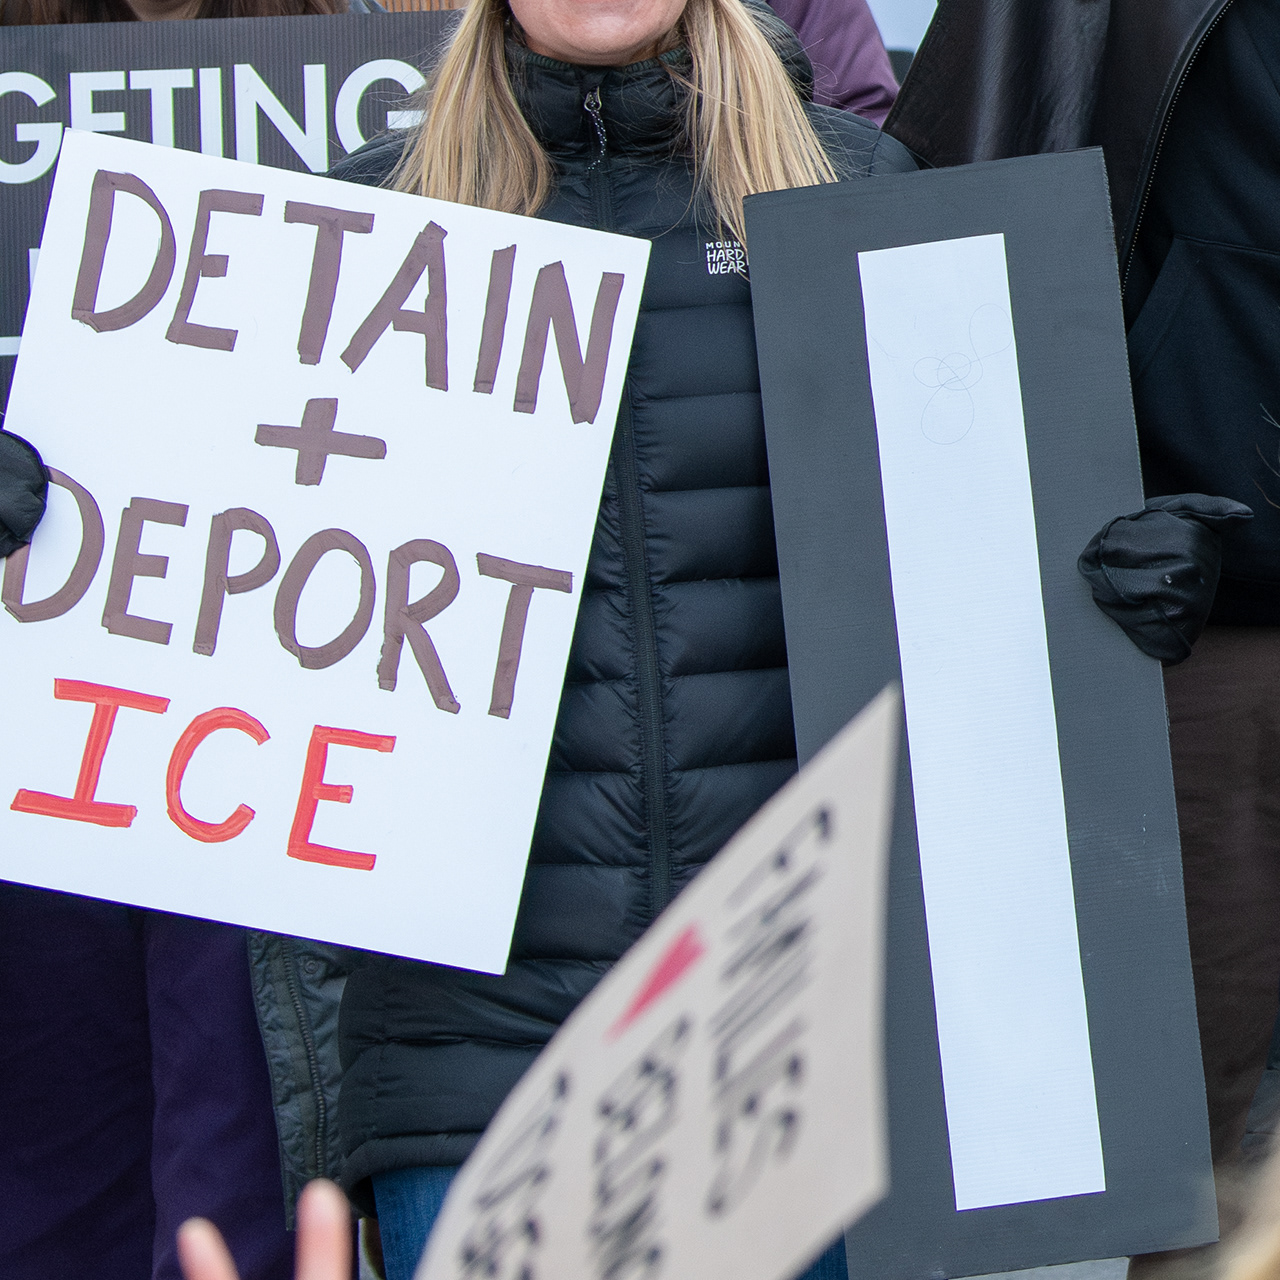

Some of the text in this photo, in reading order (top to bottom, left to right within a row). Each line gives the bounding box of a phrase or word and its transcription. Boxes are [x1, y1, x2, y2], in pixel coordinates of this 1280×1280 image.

[72, 169, 624, 424] DETAIN
[706, 248, 745, 262] HARD
[707, 260, 747, 275] WEAR
[2, 465, 573, 719] DEPORT
[10, 677, 397, 871] ICE
